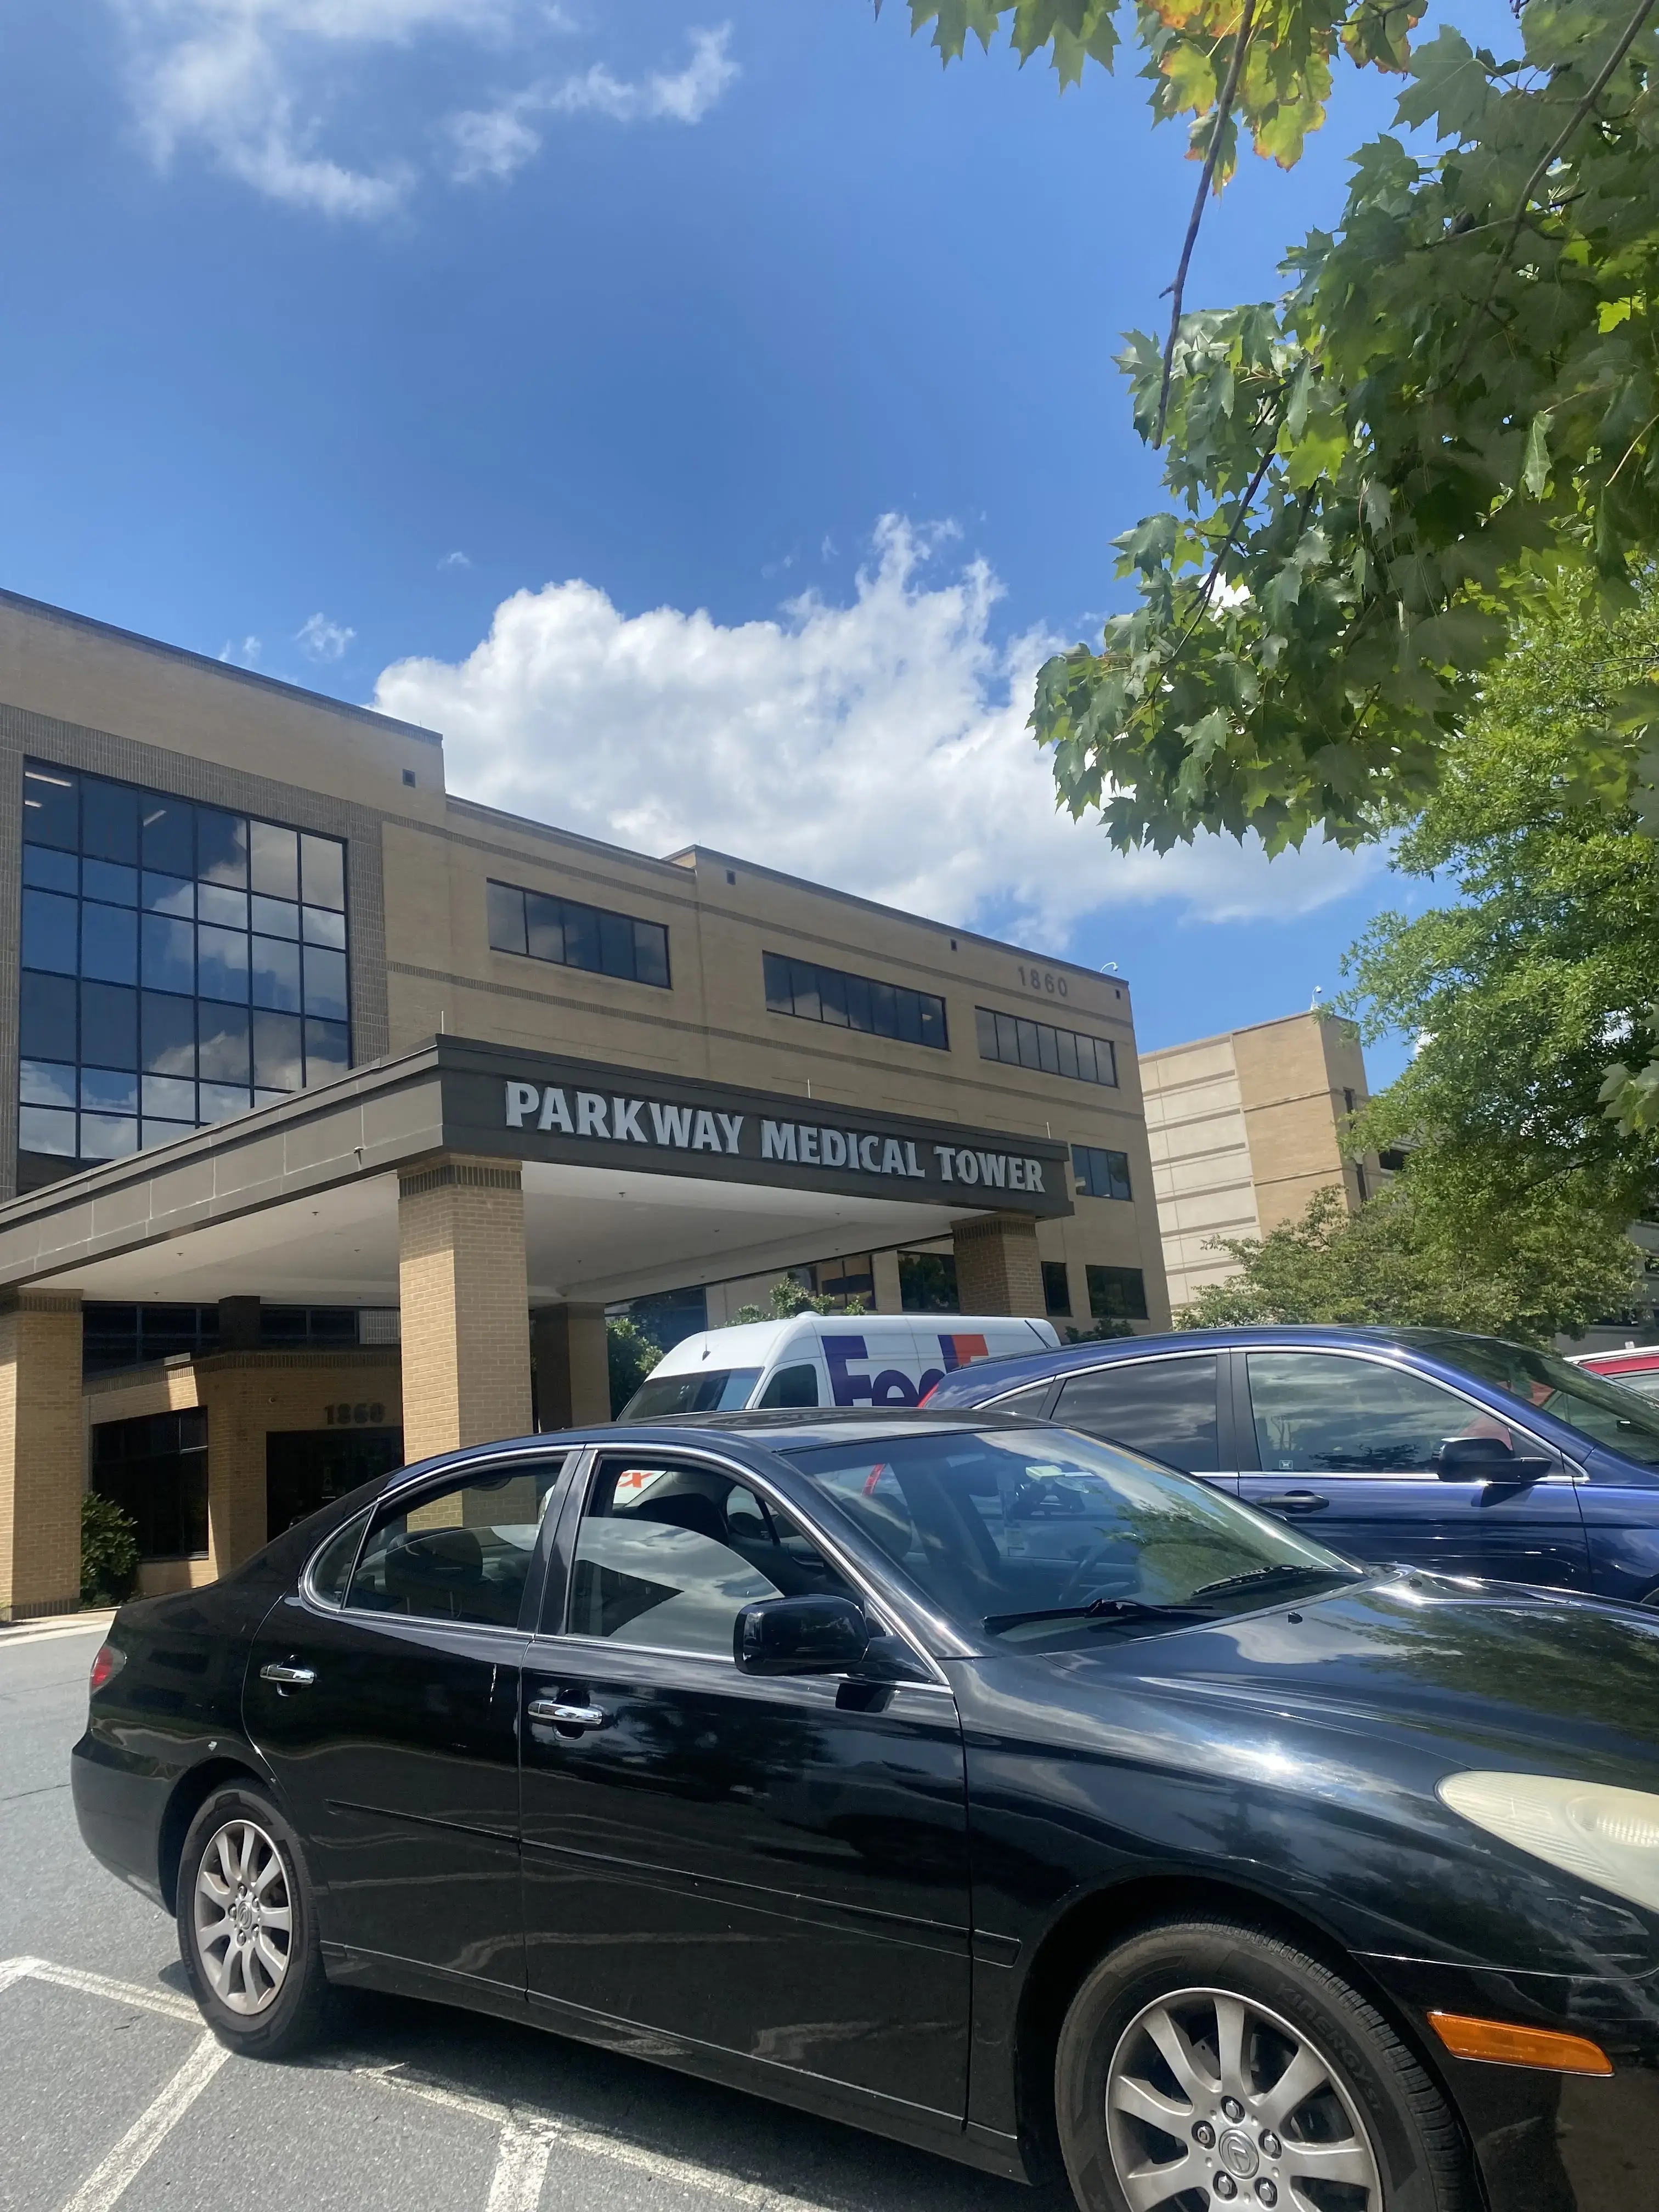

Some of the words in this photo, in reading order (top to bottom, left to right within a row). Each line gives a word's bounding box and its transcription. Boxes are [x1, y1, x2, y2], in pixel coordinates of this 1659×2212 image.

[1018, 966, 1068, 997] 1860
[505, 1081, 743, 1154] PARKWAY
[761, 1119, 925, 1178] MEDICAL
[933, 1145, 1045, 1193] TOWER
[324, 1402, 385, 1425] 1860
